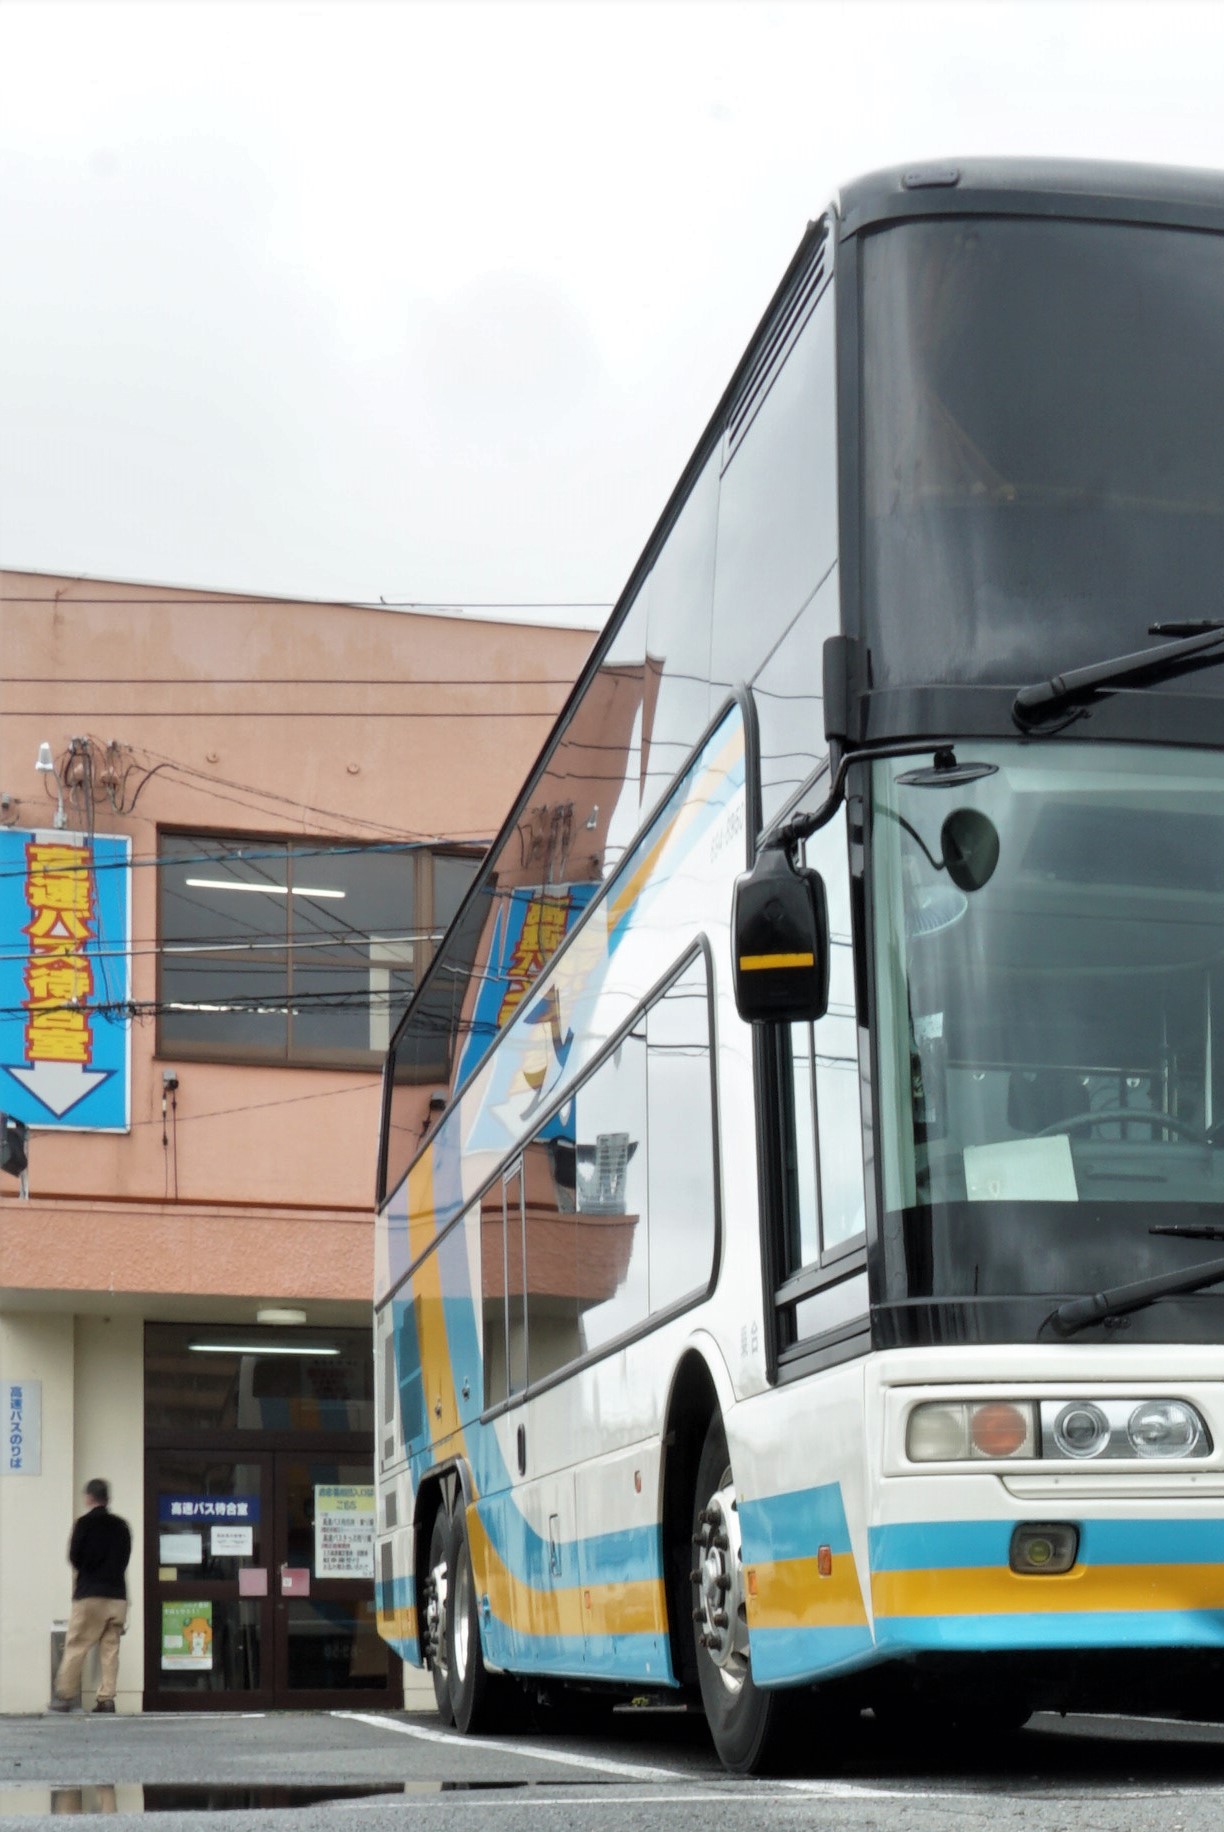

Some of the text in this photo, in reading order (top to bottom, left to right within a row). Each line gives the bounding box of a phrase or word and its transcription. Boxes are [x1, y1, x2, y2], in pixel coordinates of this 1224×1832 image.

[26, 844, 92, 1062] 高速バス待合室
[10, 1386, 22, 1468] 高速バスのりば
[171, 1502, 248, 1516] 高速バス待合室
